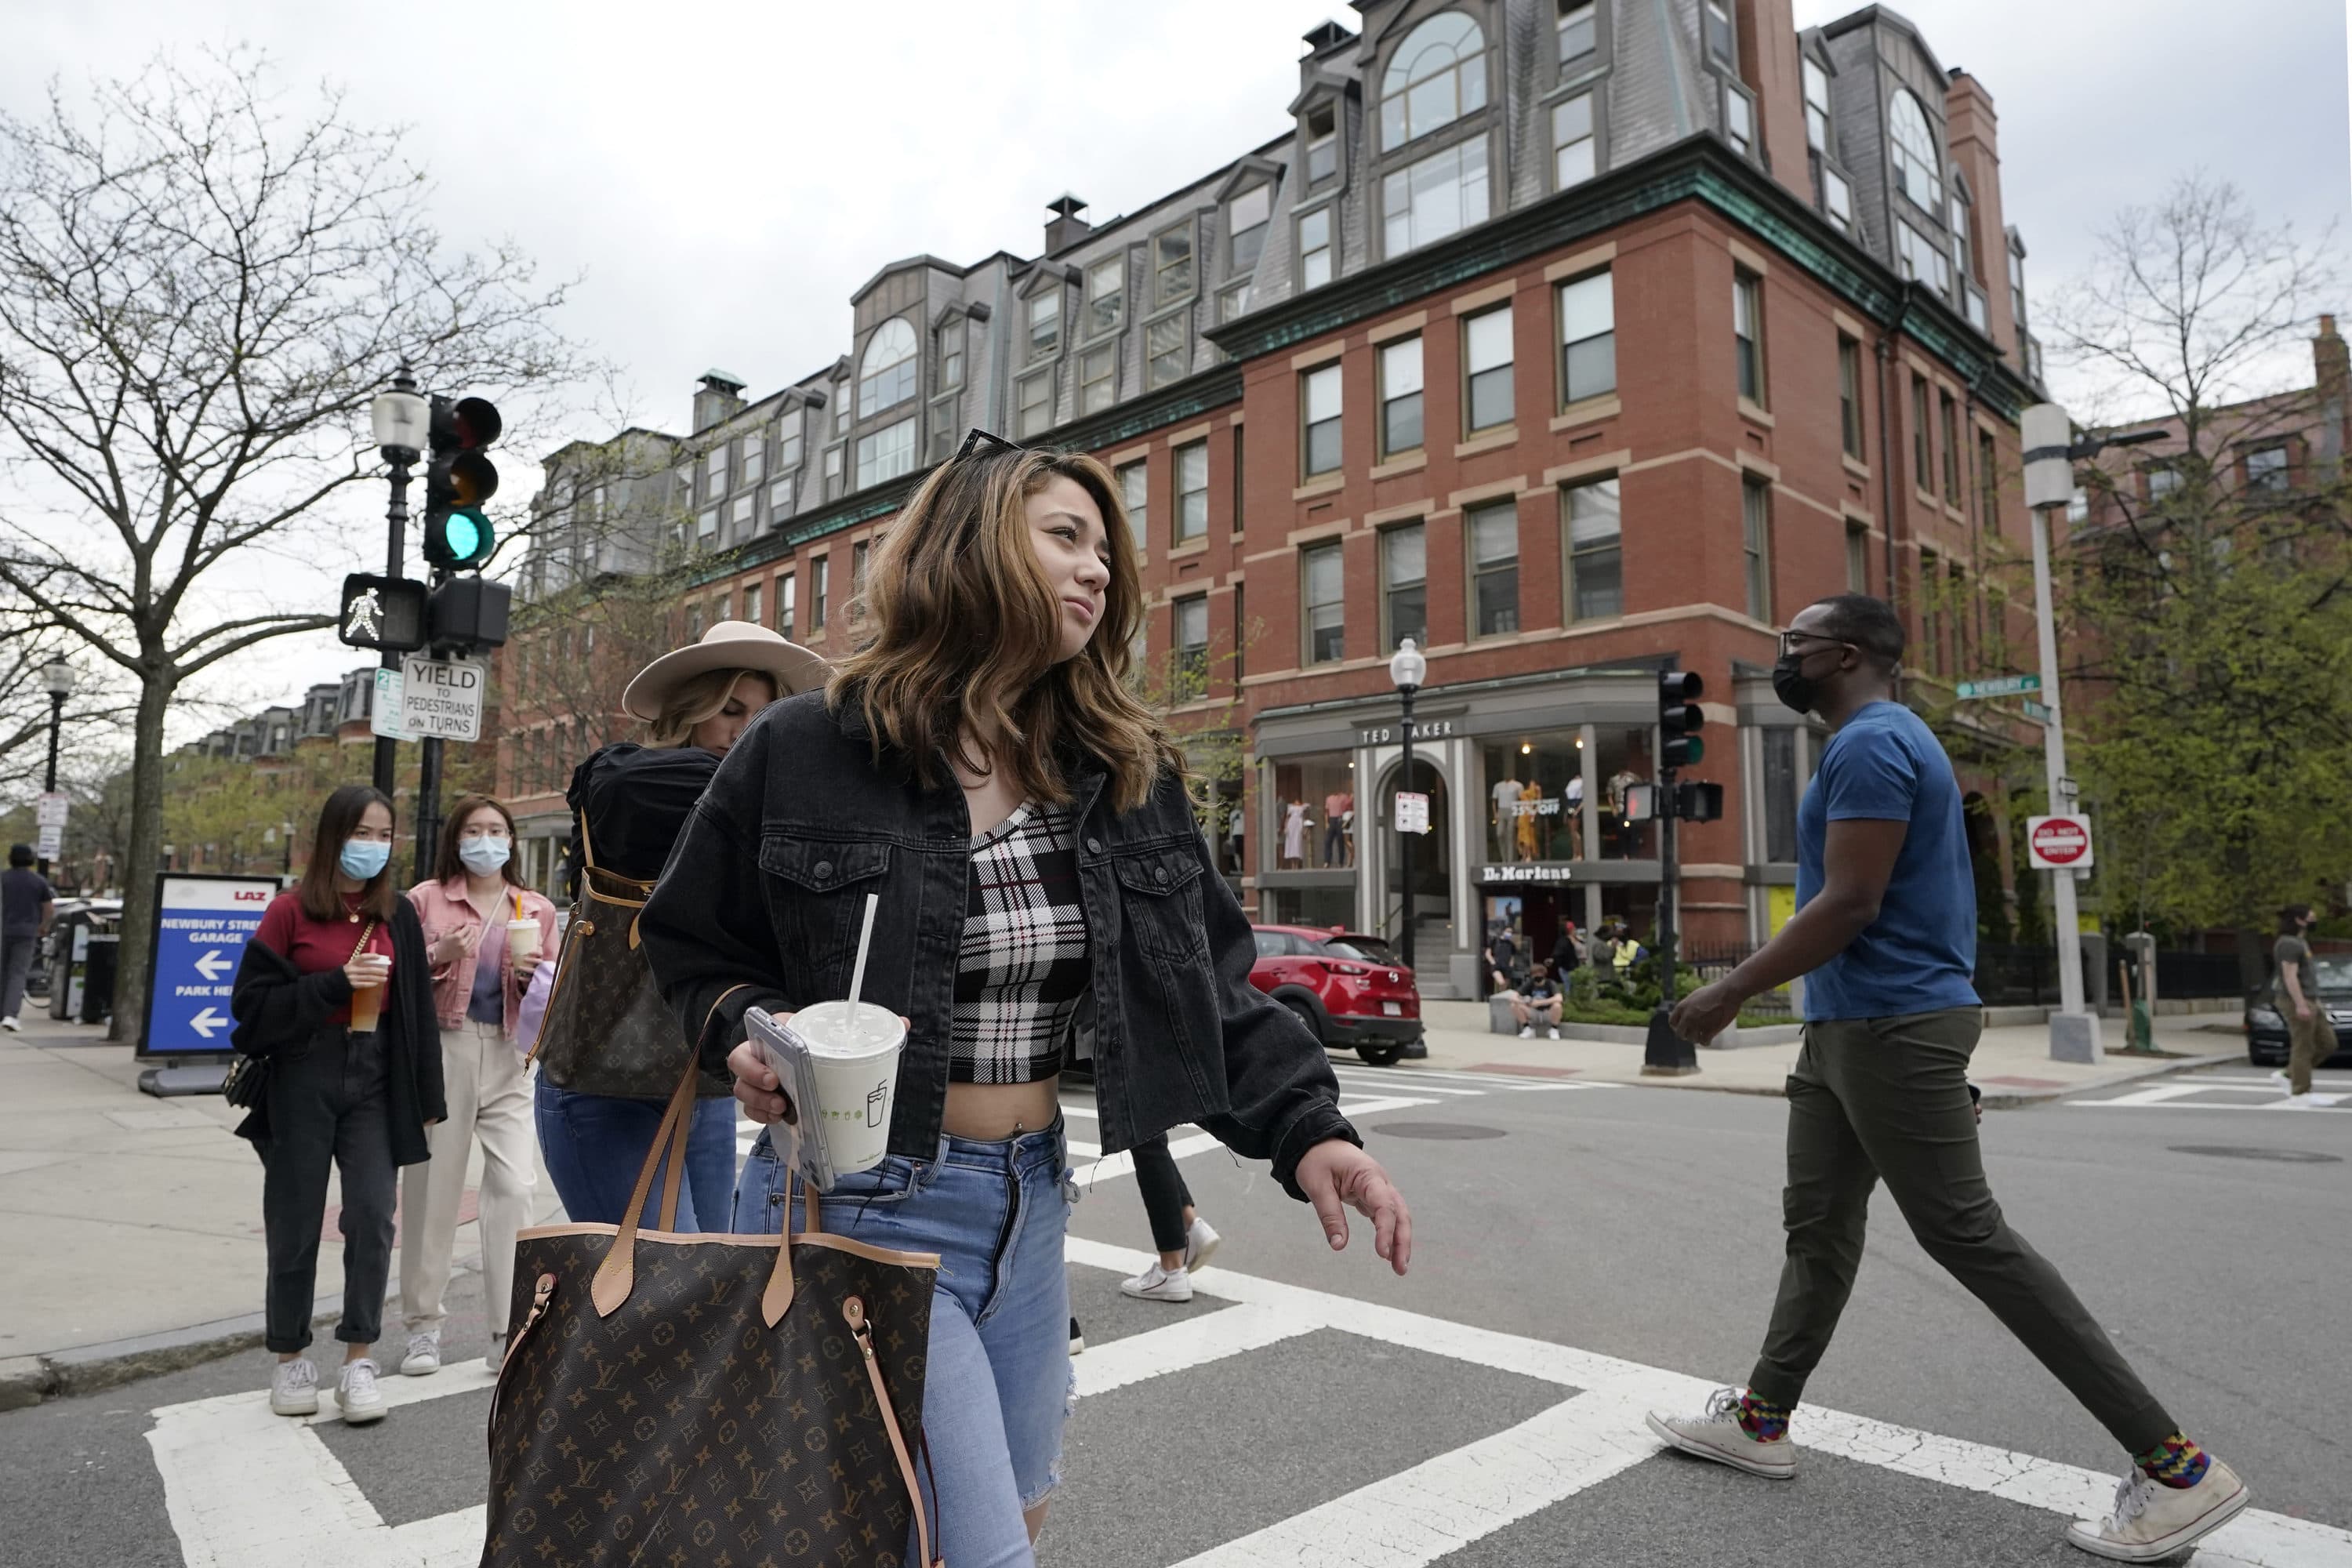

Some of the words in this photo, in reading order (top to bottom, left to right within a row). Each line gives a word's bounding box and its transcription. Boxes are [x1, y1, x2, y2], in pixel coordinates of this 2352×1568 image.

[378, 673, 389, 685] 2
[413, 664, 476, 688] YIELD
[437, 688, 451, 698] TO
[407, 696, 475, 717] PEDESTRIANS
[408, 717, 425, 728] ON
[429, 715, 470, 733] TURNS
[1363, 728, 1390, 743] TED
[1411, 721, 1451, 738] AKER
[1538, 803, 1560, 815] OFF
[2037, 827, 2055, 837] DO
[2057, 826, 2079, 836] NOT
[2043, 847, 2078, 856] ENTER
[1501, 866, 1571, 880] Martens
[234, 891, 267, 902] LAZ
[161, 918, 225, 931] NEWBURY
[188, 932, 244, 944] GARAGE
[175, 985, 212, 997] PARK
